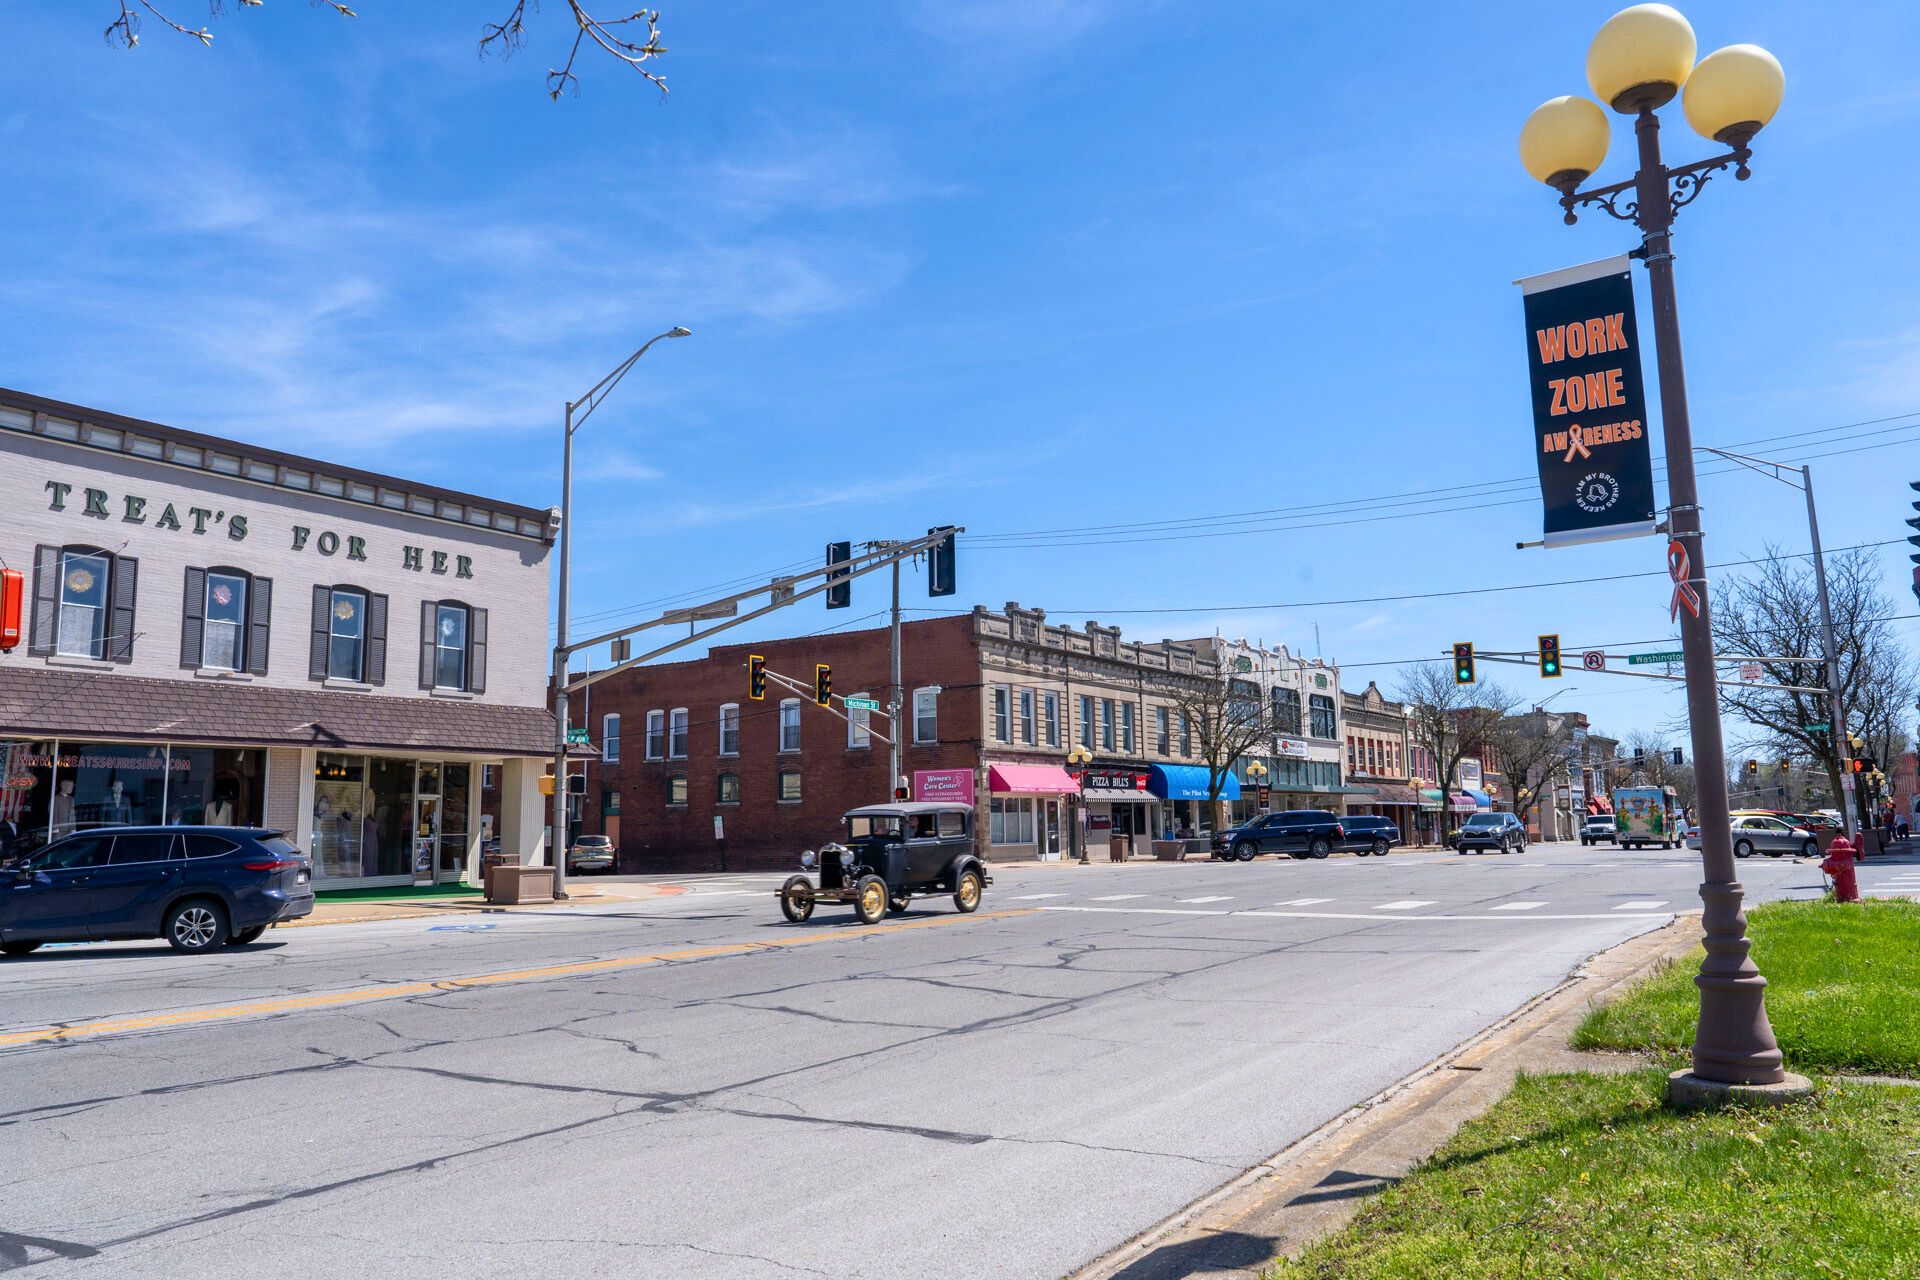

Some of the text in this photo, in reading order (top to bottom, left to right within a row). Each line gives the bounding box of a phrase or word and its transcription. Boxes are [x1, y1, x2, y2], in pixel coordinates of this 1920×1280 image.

[1536, 312, 1628, 365] WORK
[1548, 368, 1626, 416] ZONE
[1585, 472, 1597, 481] MY
[1576, 480, 1586, 492] AM
[1599, 472, 1619, 508] BROTHERS
[1576, 497, 1606, 512] KEEPER
[44, 480, 474, 579] TREAT'S FOR HER
[848, 699, 870, 709] Michigan
[6, 776, 36, 787] OPEN
[927, 775, 953, 783] Women's
[1092, 776, 1110, 787] PIZZA
[1112, 777, 1129, 787] BILL'S
[923, 782, 959, 791] Care Center
